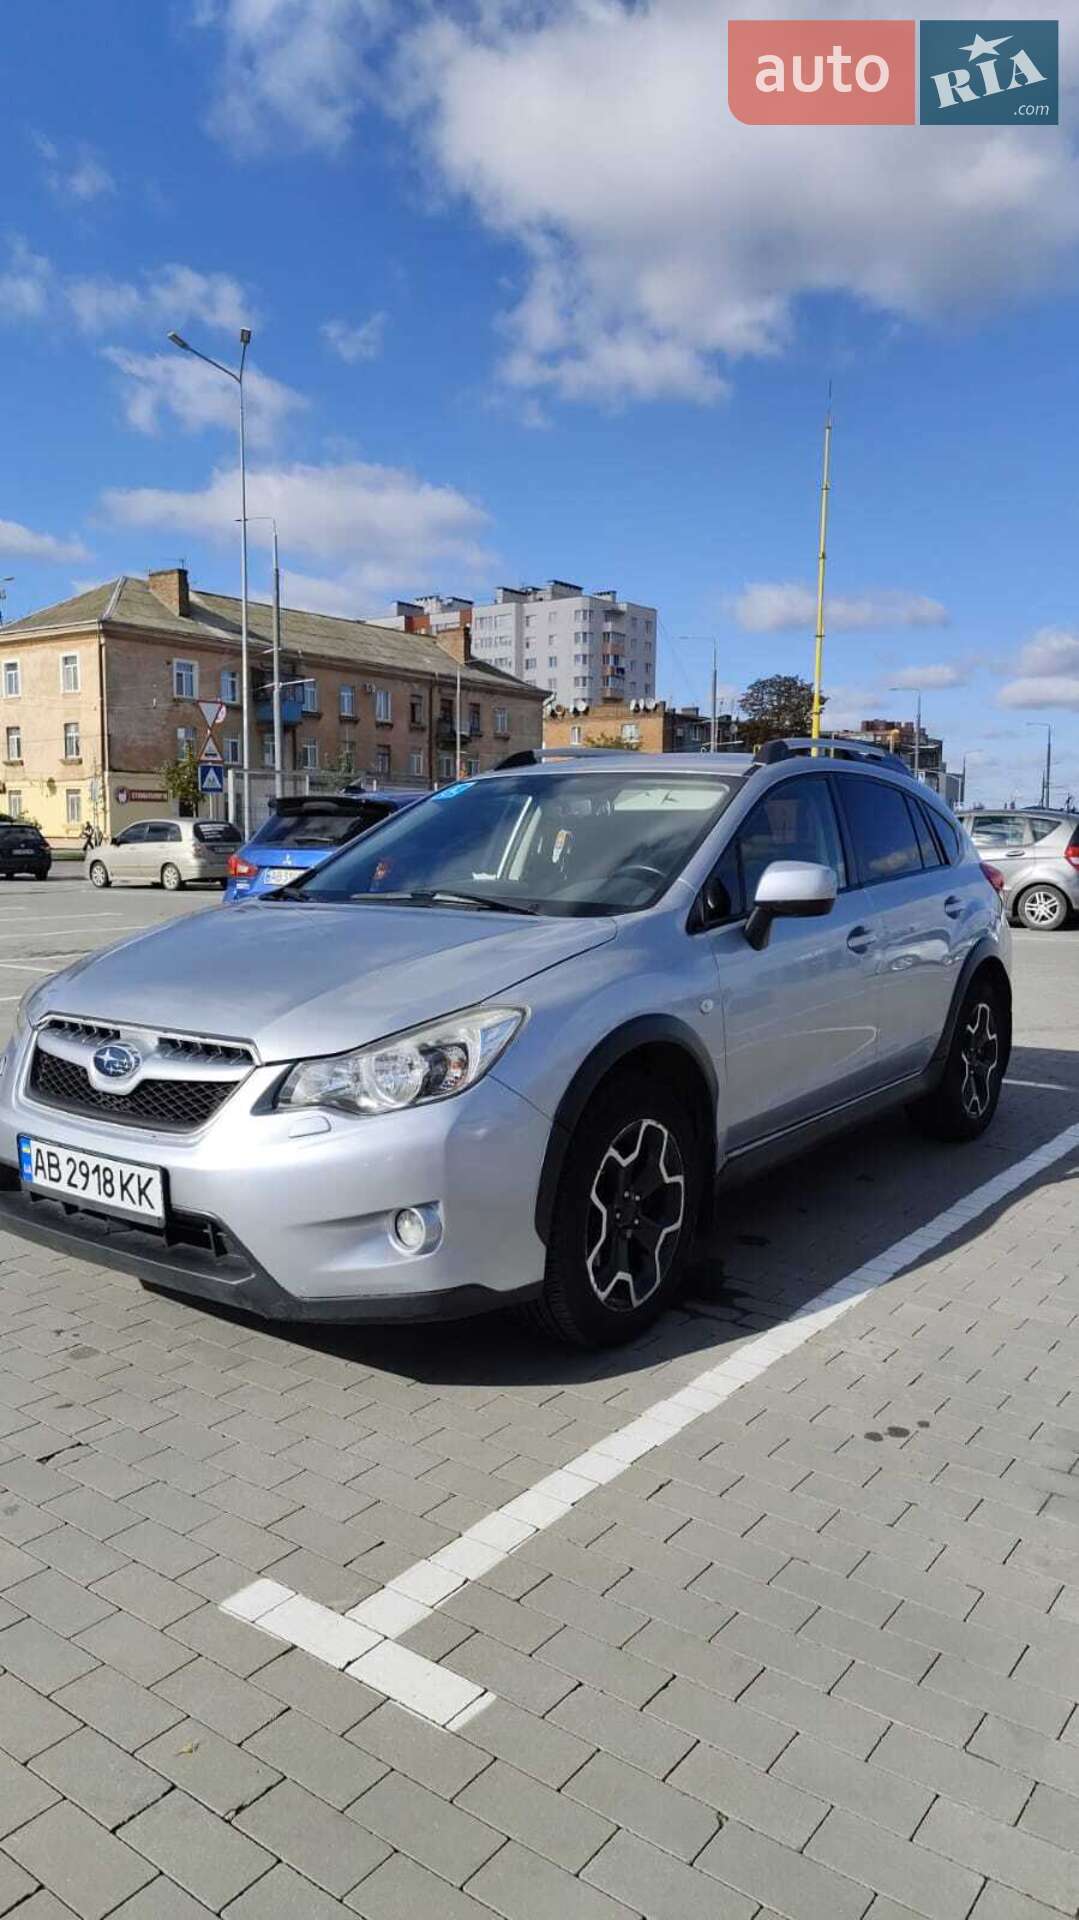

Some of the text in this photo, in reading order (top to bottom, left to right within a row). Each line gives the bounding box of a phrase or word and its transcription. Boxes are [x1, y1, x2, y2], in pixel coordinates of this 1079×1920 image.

[34, 1148, 155, 1210] AB 2918 KK
